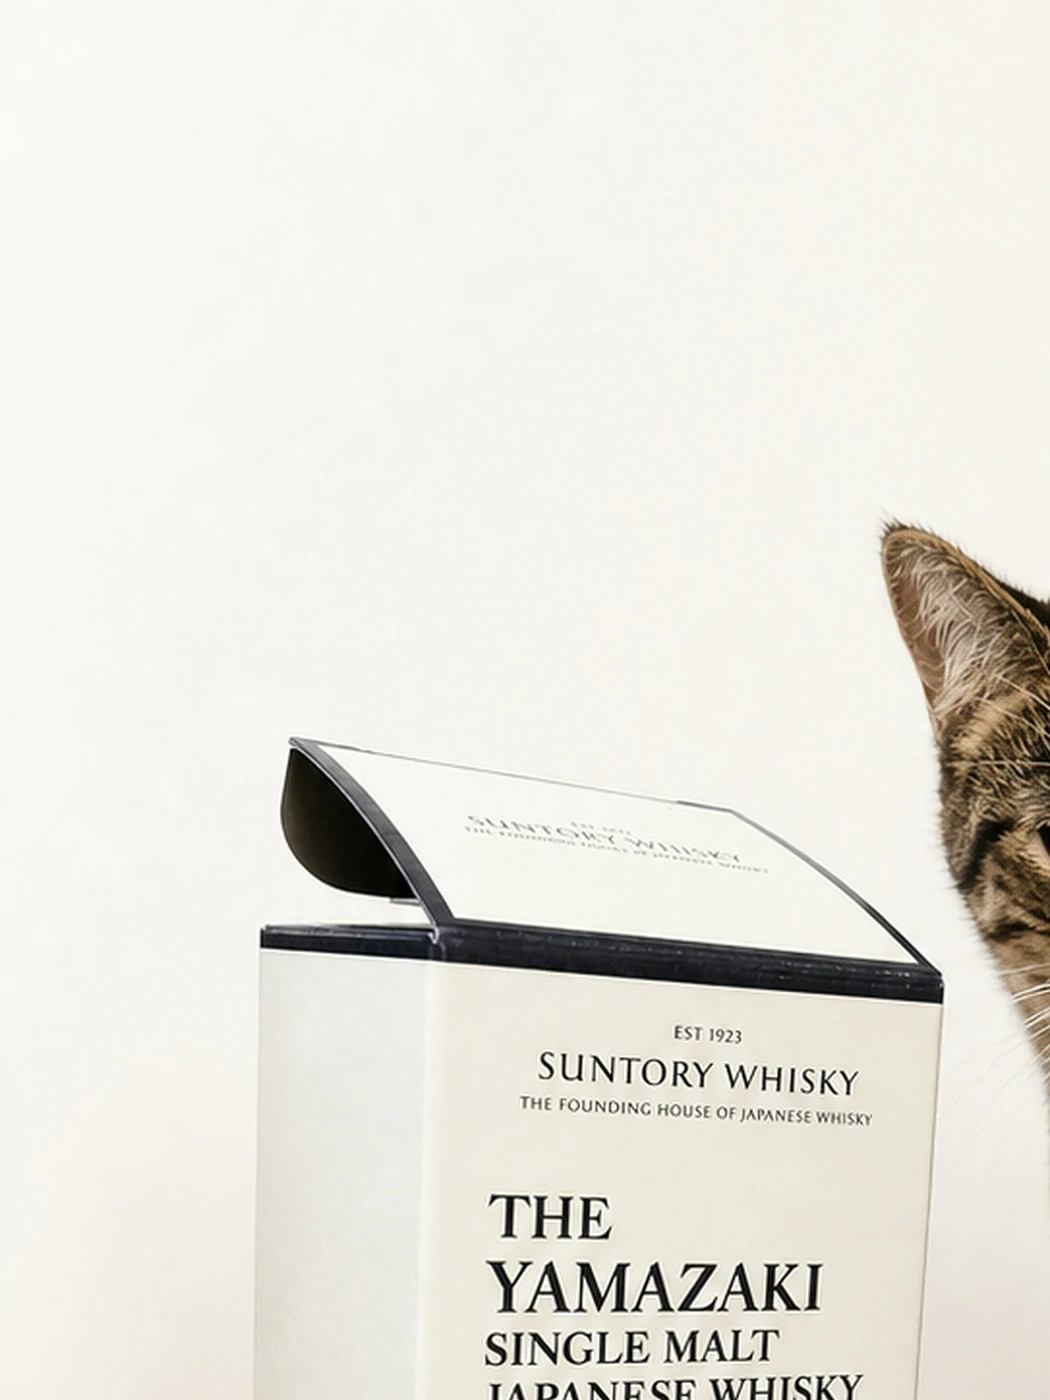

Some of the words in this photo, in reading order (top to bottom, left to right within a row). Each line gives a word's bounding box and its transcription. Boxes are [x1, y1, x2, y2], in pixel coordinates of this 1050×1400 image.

[674, 1024, 703, 1041] EST
[709, 1028, 742, 1045] 1923
[538, 1051, 714, 1089] SUNTORY
[724, 1063, 859, 1096] WHISKY
[519, 1095, 552, 1111] THE
[559, 1097, 652, 1116] FOUNDING
[657, 1103, 711, 1119] HOUSE
[715, 1105, 736, 1120] OF
[739, 1108, 811, 1124] JAPANESE
[815, 1111, 873, 1126] WHISKY
[488, 1193, 613, 1240] THE
[485, 1260, 823, 1314] YAMAZAKI
[484, 1330, 651, 1367] SINGLE
[663, 1329, 780, 1364] MALT
